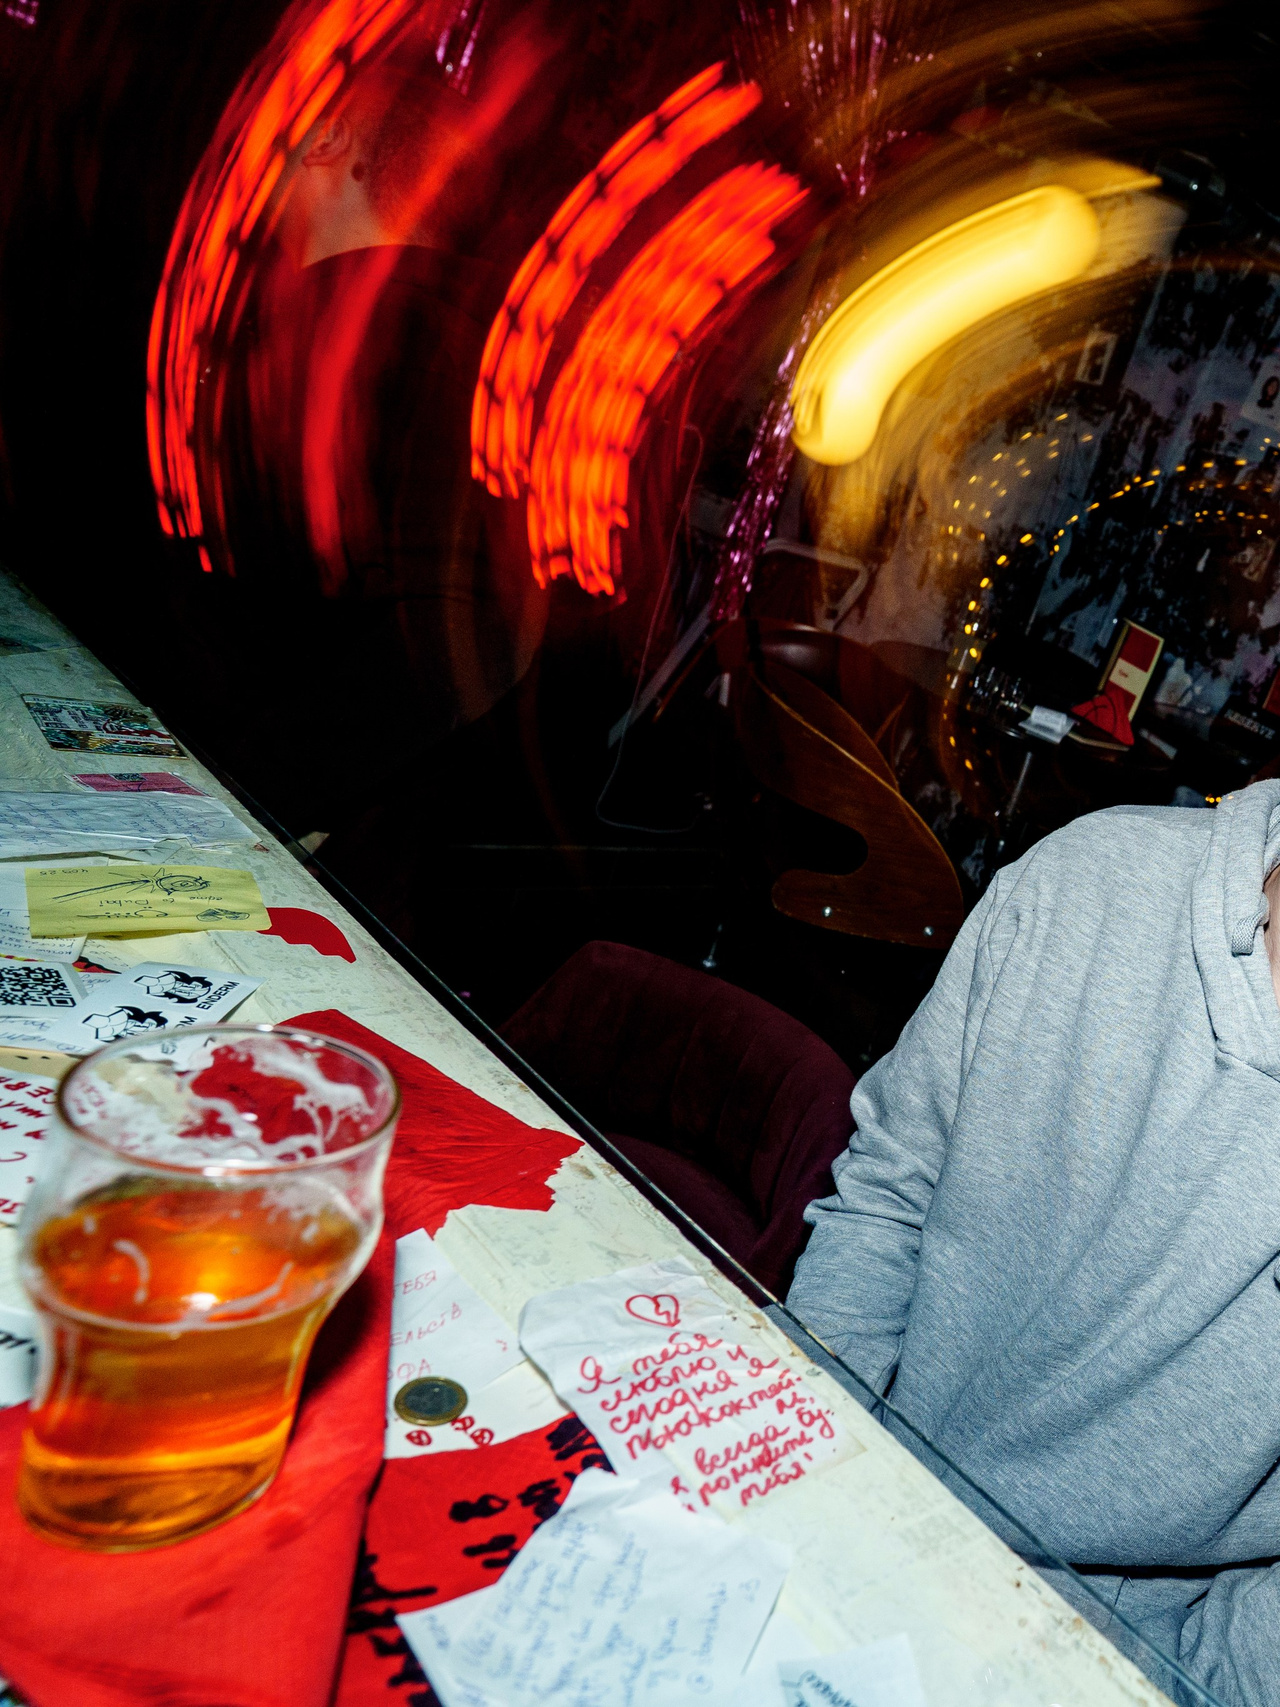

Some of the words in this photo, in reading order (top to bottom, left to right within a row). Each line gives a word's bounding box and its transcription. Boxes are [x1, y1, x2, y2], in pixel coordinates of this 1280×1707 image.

[196, 981, 239, 1010] ENDERM
[577, 1355, 622, 1394] Я
[632, 1332, 723, 1376] тебя
[600, 1356, 717, 1411] люблю
[610, 1369, 739, 1433] сегодня
[747, 1357, 780, 1377] я
[694, 1425, 790, 1475] всегда
